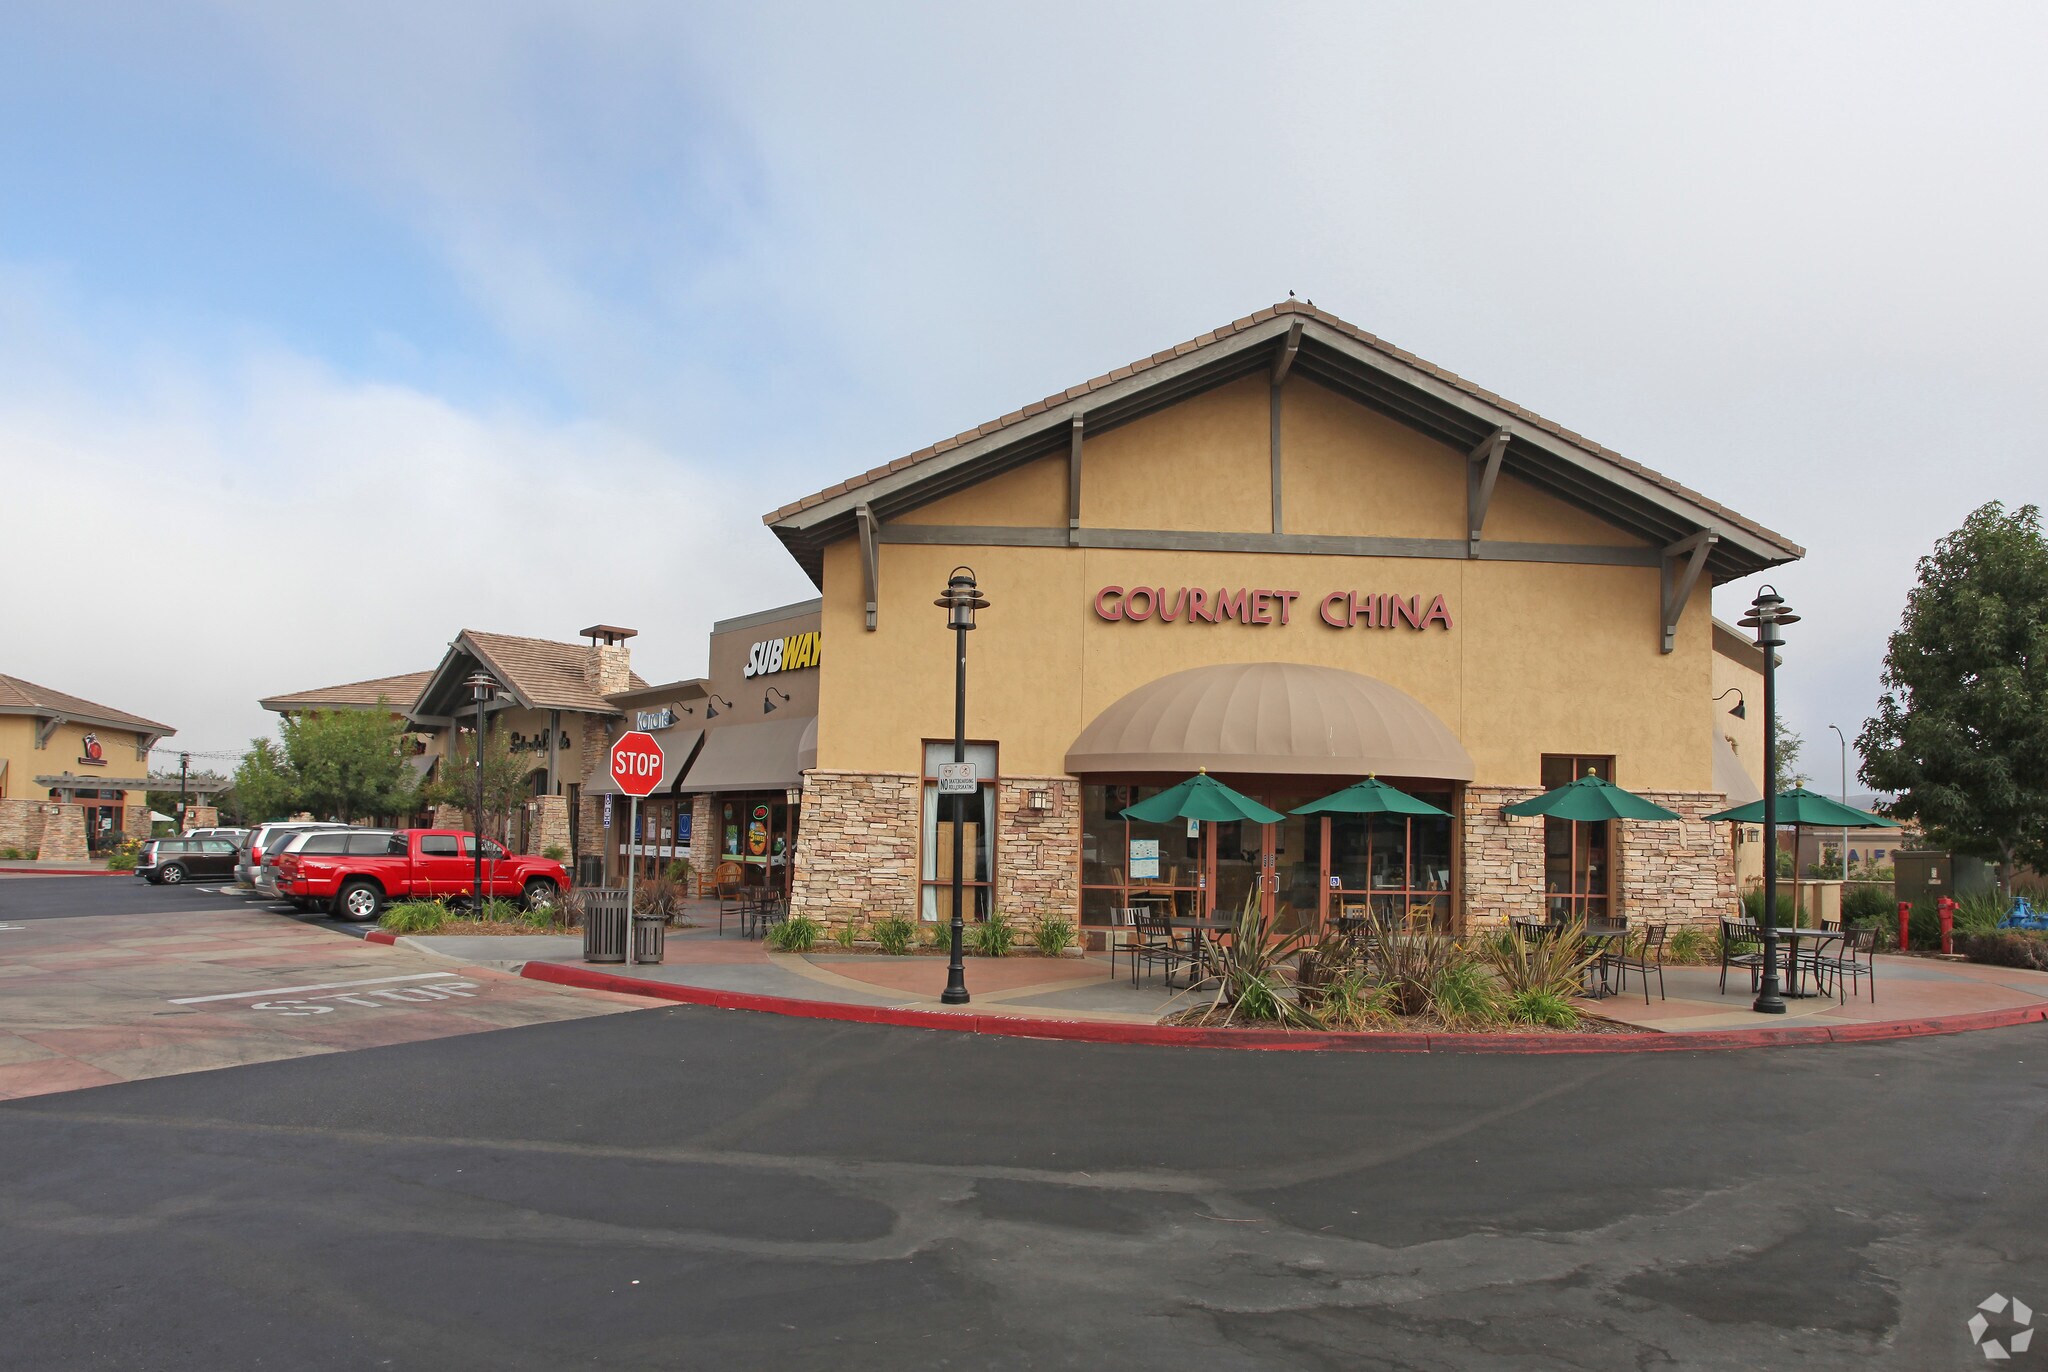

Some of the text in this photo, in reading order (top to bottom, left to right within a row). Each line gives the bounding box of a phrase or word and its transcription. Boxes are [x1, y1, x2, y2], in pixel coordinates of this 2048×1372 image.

[1094, 585, 1454, 630] GOURMET CHINA
[743, 631, 822, 679] SUBWAY
[615, 750, 660, 776] STOP
[940, 778, 949, 790] NO
[1190, 820, 1199, 830] A
[251, 982, 480, 1016] STOP
